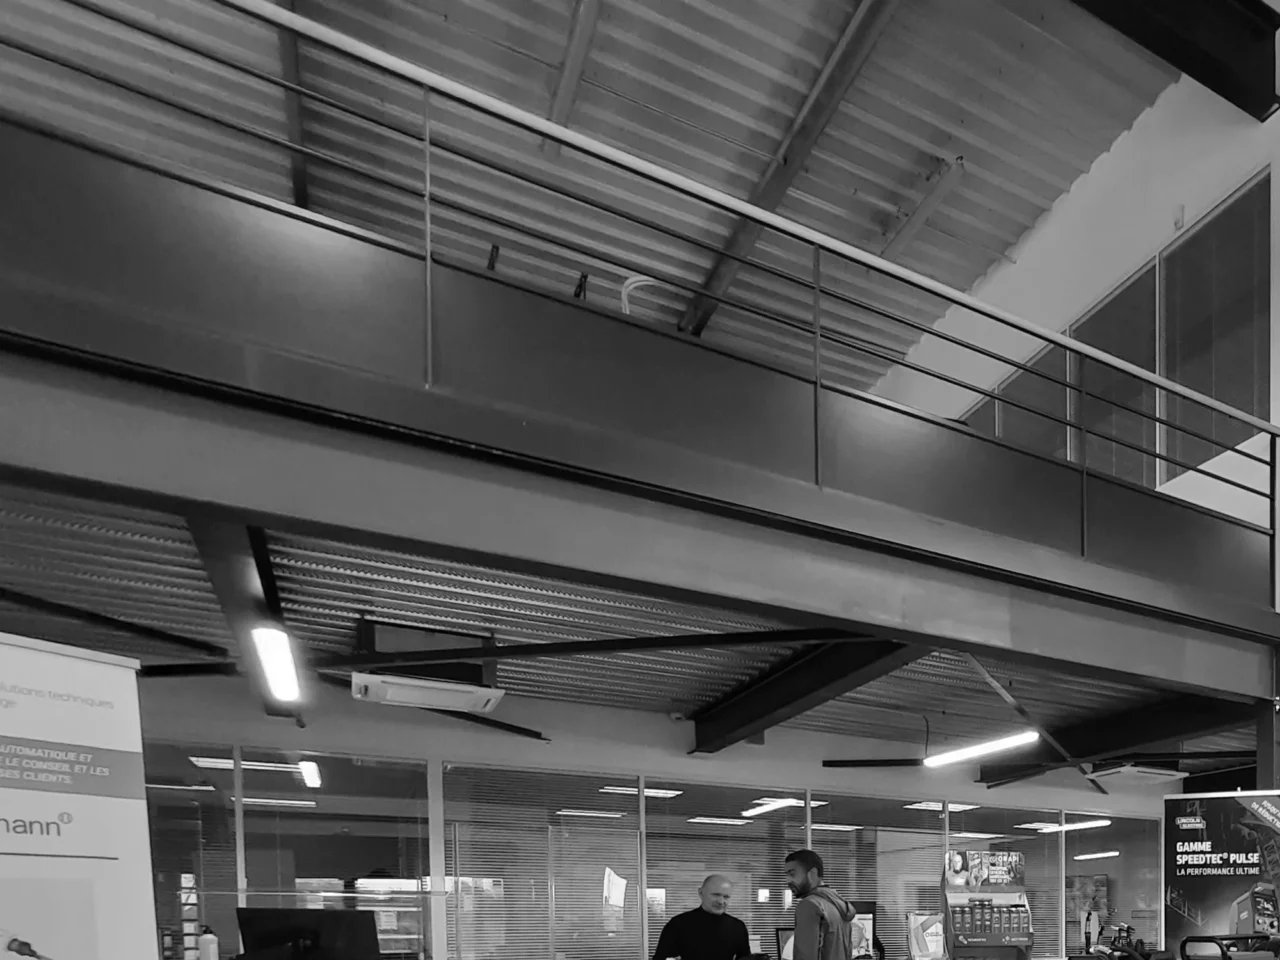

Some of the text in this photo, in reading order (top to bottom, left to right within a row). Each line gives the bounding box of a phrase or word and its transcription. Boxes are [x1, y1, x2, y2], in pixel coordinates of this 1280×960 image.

[1176, 841, 1212, 853] GAMME
[1229, 853, 1260, 864] PULSE
[1176, 866, 1260, 876] LA PERFORMANCE ULTIME
